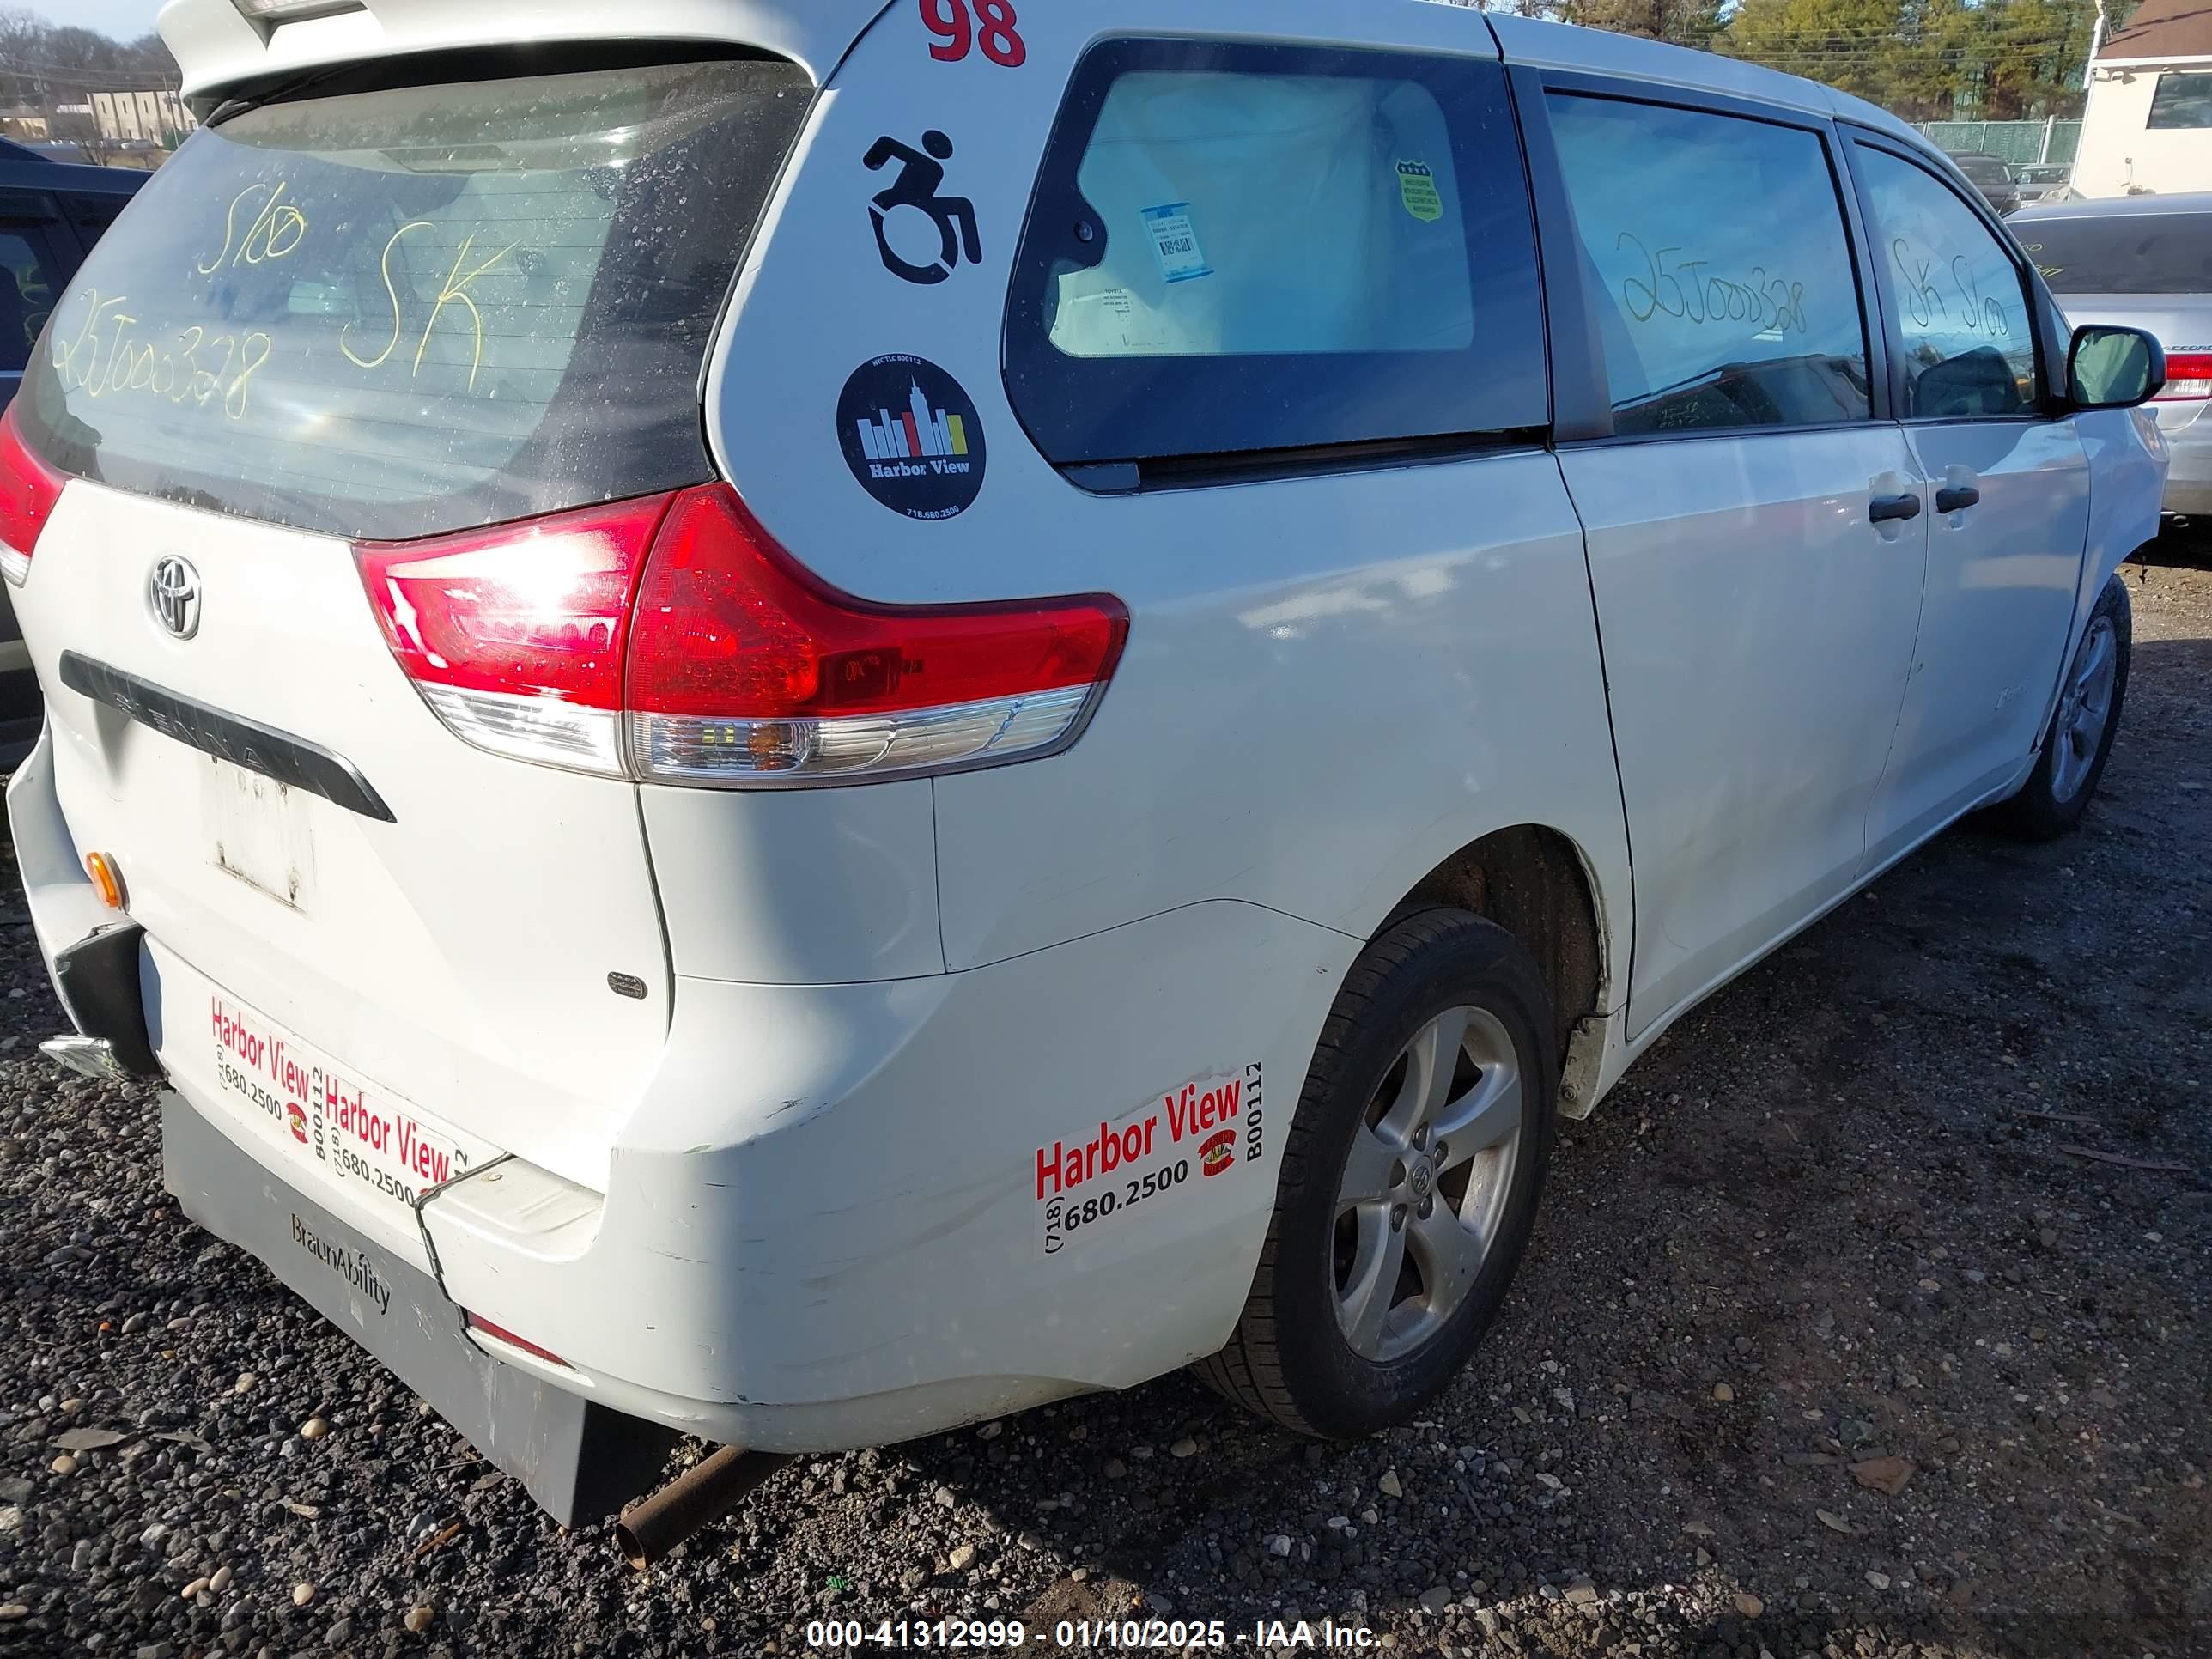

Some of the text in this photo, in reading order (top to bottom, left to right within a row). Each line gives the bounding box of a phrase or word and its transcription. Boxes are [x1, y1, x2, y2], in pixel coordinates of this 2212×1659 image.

[919, 0, 1026, 67] 98
[872, 356, 885, 367] NYC
[896, 355, 921, 365] B00112
[869, 459, 969, 478] Harbor View
[907, 505, 959, 519] 718.680.2500
[212, 996, 309, 1103] Harbor View
[216, 1043, 228, 1091] (718)
[225, 1064, 282, 1121] 680.2500
[313, 1066, 325, 1161] B00112
[325, 1074, 450, 1183] Harbor View
[1036, 1079, 1241, 1200] Harbor View
[1246, 1061, 1263, 1162] B00112
[331, 1127, 346, 1177] (718)
[342, 1148, 415, 1208] 680.2500
[1045, 1159, 1188, 1254] (718) 680.2500
[291, 1212, 391, 1316] BraunAbility
